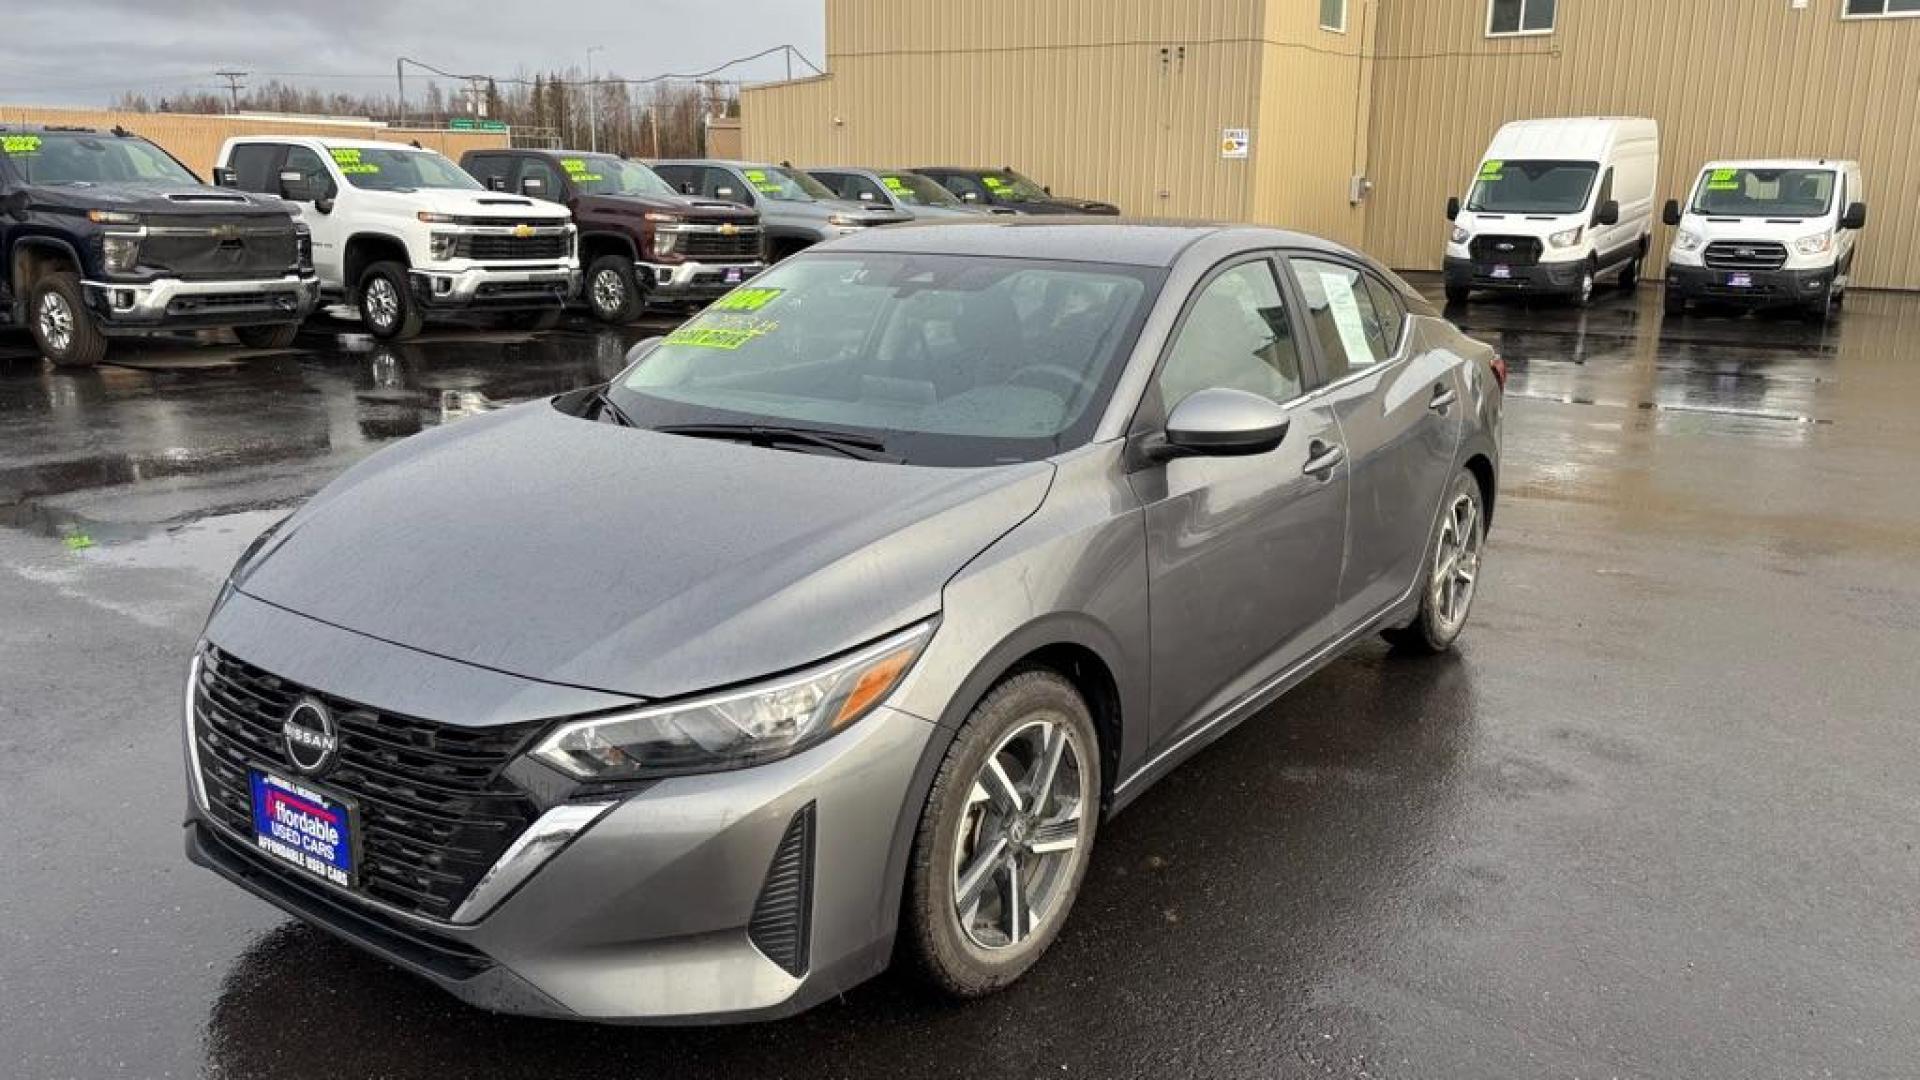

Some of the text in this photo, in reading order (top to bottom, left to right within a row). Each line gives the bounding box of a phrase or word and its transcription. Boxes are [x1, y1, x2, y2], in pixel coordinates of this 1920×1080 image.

[284, 723, 334, 751] NISSAN
[266, 789, 341, 848] Affordable
[271, 821, 336, 862] USED CARS
